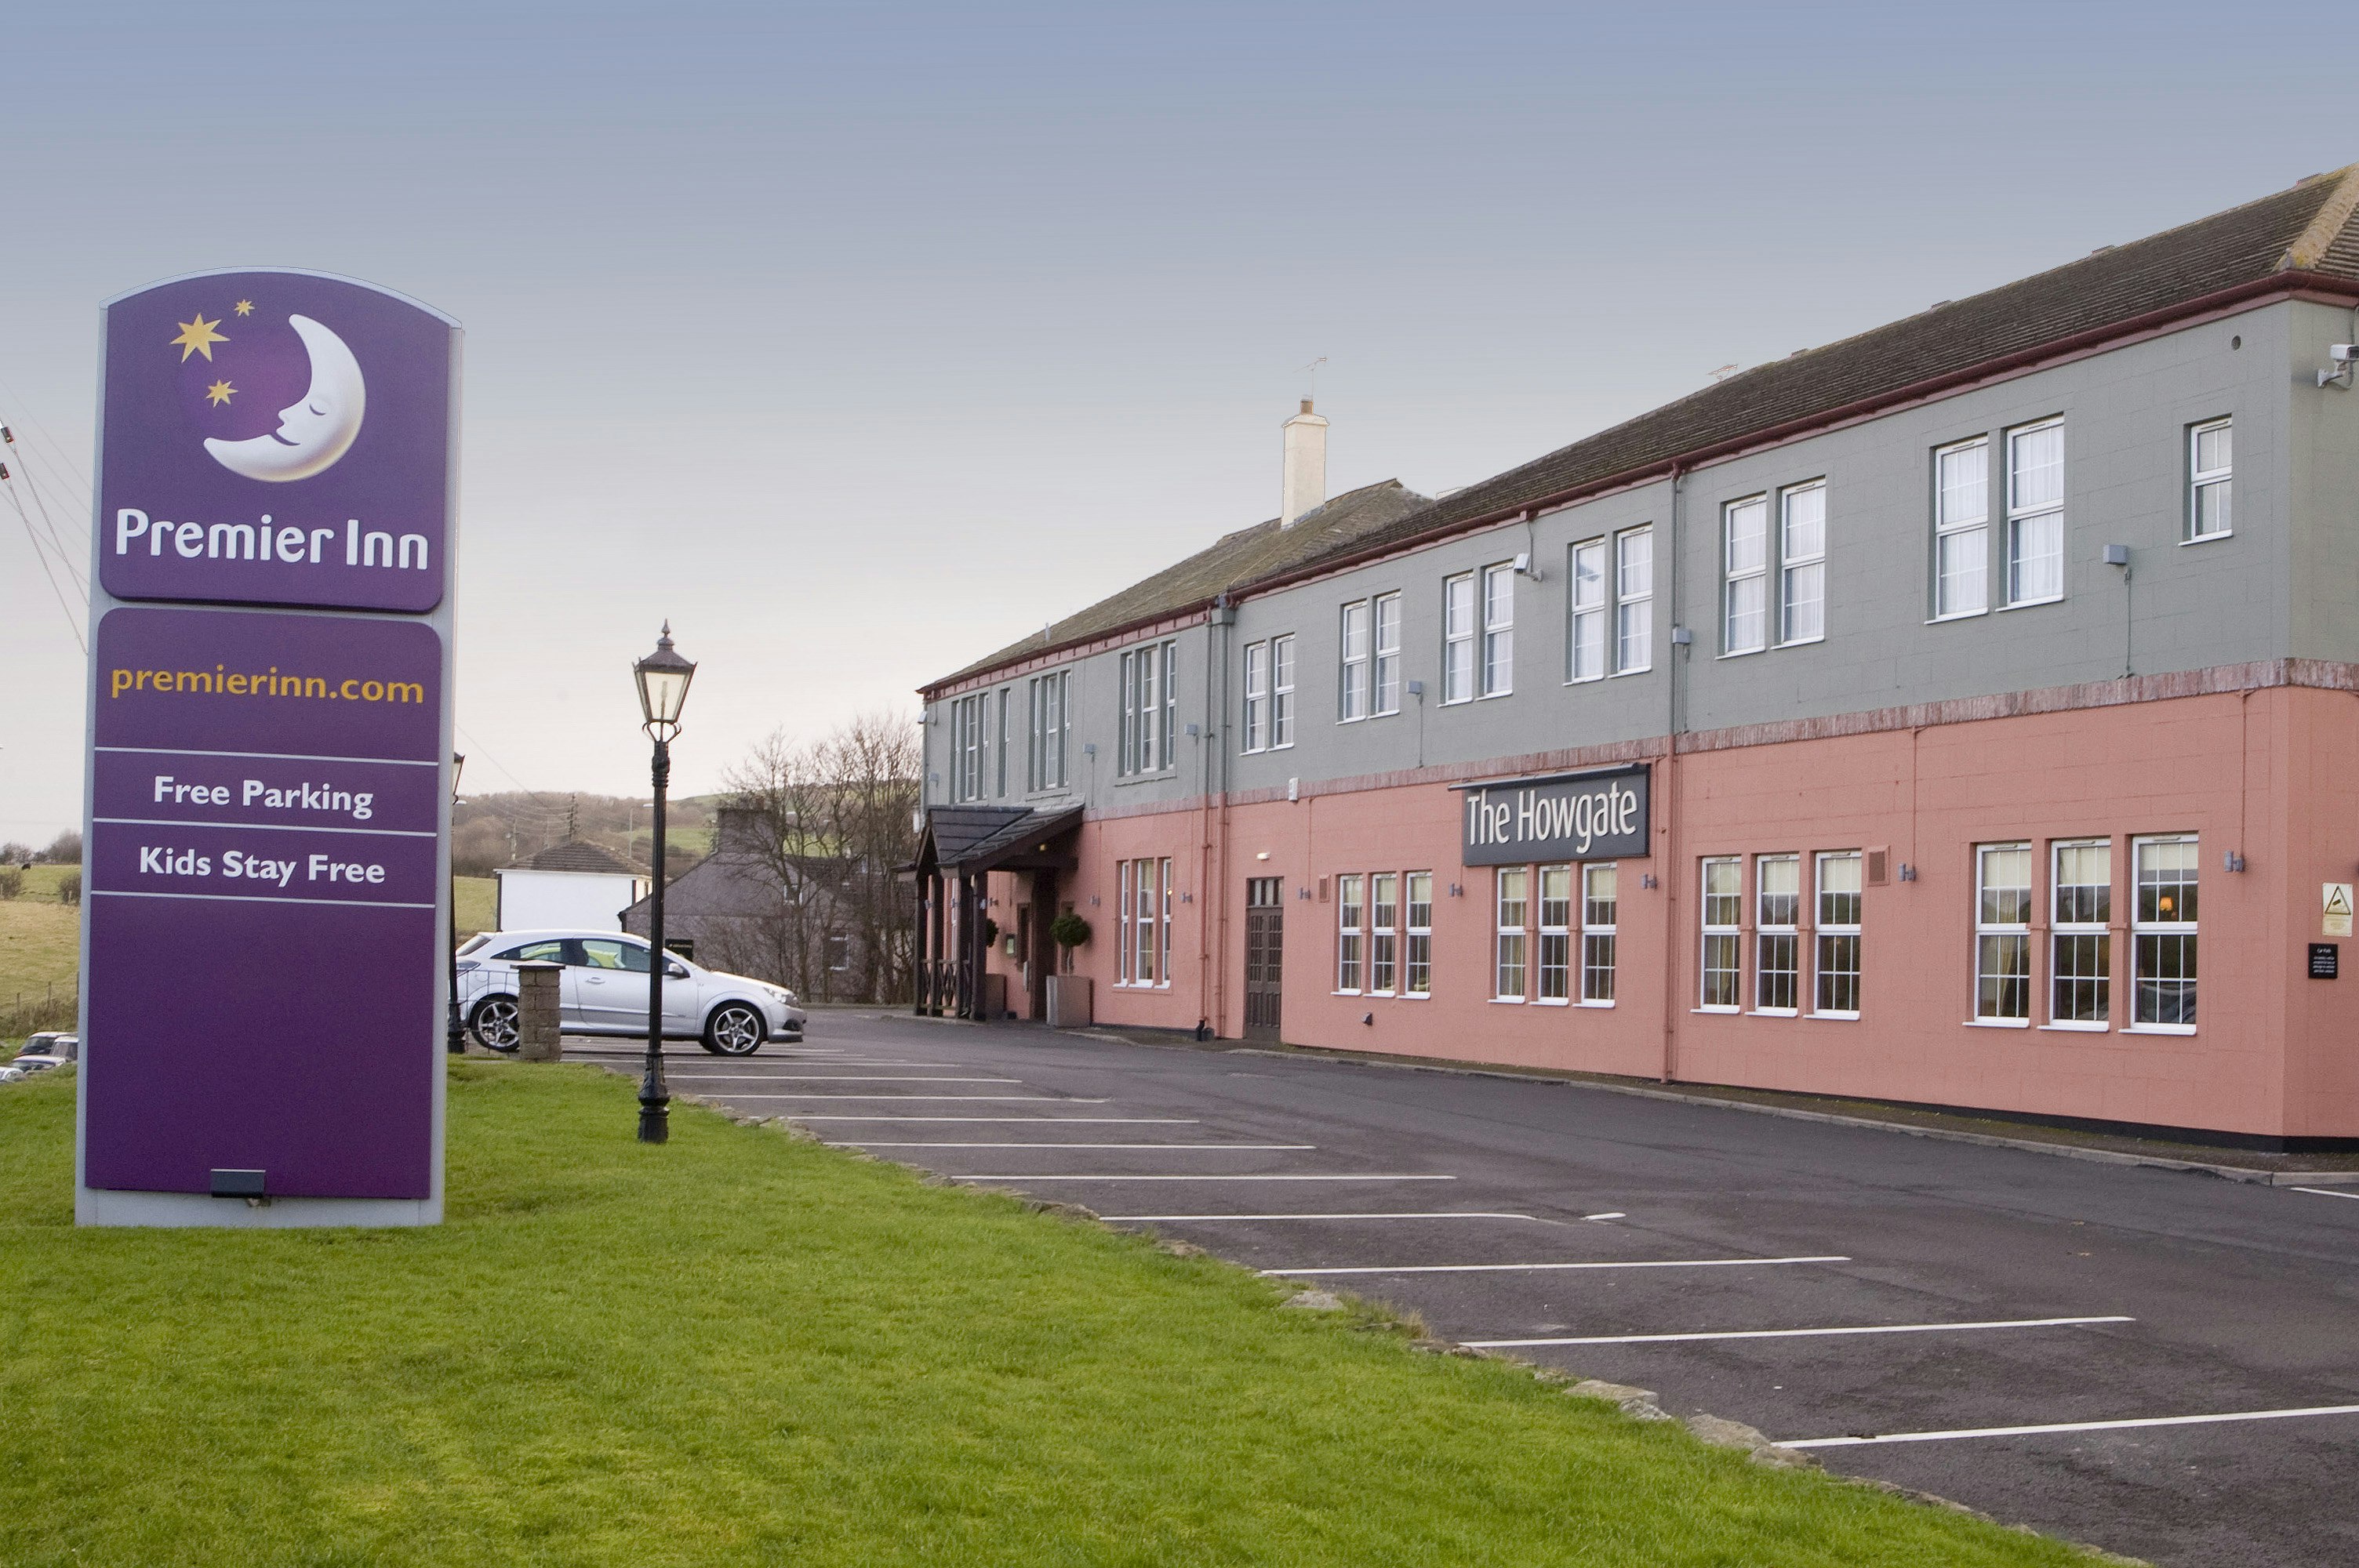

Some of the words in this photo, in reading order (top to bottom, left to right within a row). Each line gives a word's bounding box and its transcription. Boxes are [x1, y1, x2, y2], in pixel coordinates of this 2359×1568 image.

[116, 508, 334, 564] Premier
[346, 519, 428, 570] Inn
[111, 664, 424, 704] premierinn.com
[154, 775, 230, 806] Free
[242, 779, 373, 820] Parking
[1467, 788, 1510, 845] The
[1517, 781, 1638, 855] Howgate
[140, 846, 211, 877] Kids
[223, 850, 297, 887] Stay
[308, 854, 385, 884] Free
